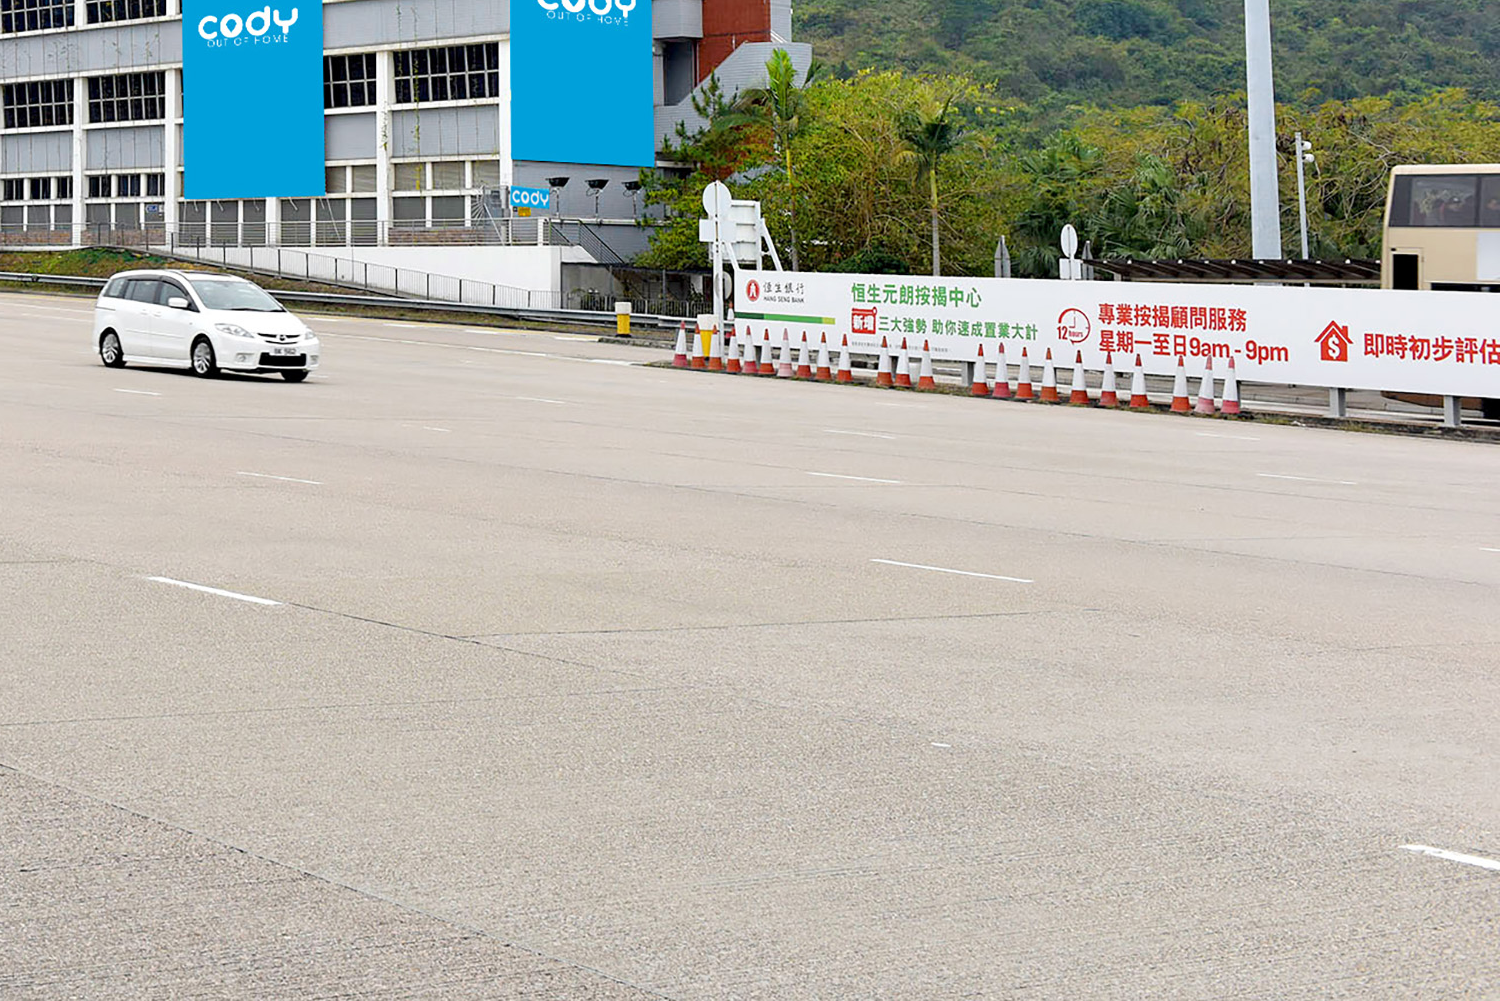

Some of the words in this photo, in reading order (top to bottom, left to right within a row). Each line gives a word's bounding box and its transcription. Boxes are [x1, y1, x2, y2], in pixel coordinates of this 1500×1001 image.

[197, 5, 298, 40] cody
[546, 10, 570, 20] OUT
[207, 38, 227, 48] OUT
[511, 190, 549, 206] cody
[851, 282, 982, 308] 恒生元朗按揭中心
[1098, 303, 1247, 332] 專業按揭顧問服務
[1056, 326, 1068, 340] 12
[1245, 340, 1289, 365] 9pm
[1363, 332, 1500, 365] 即時初步評估
